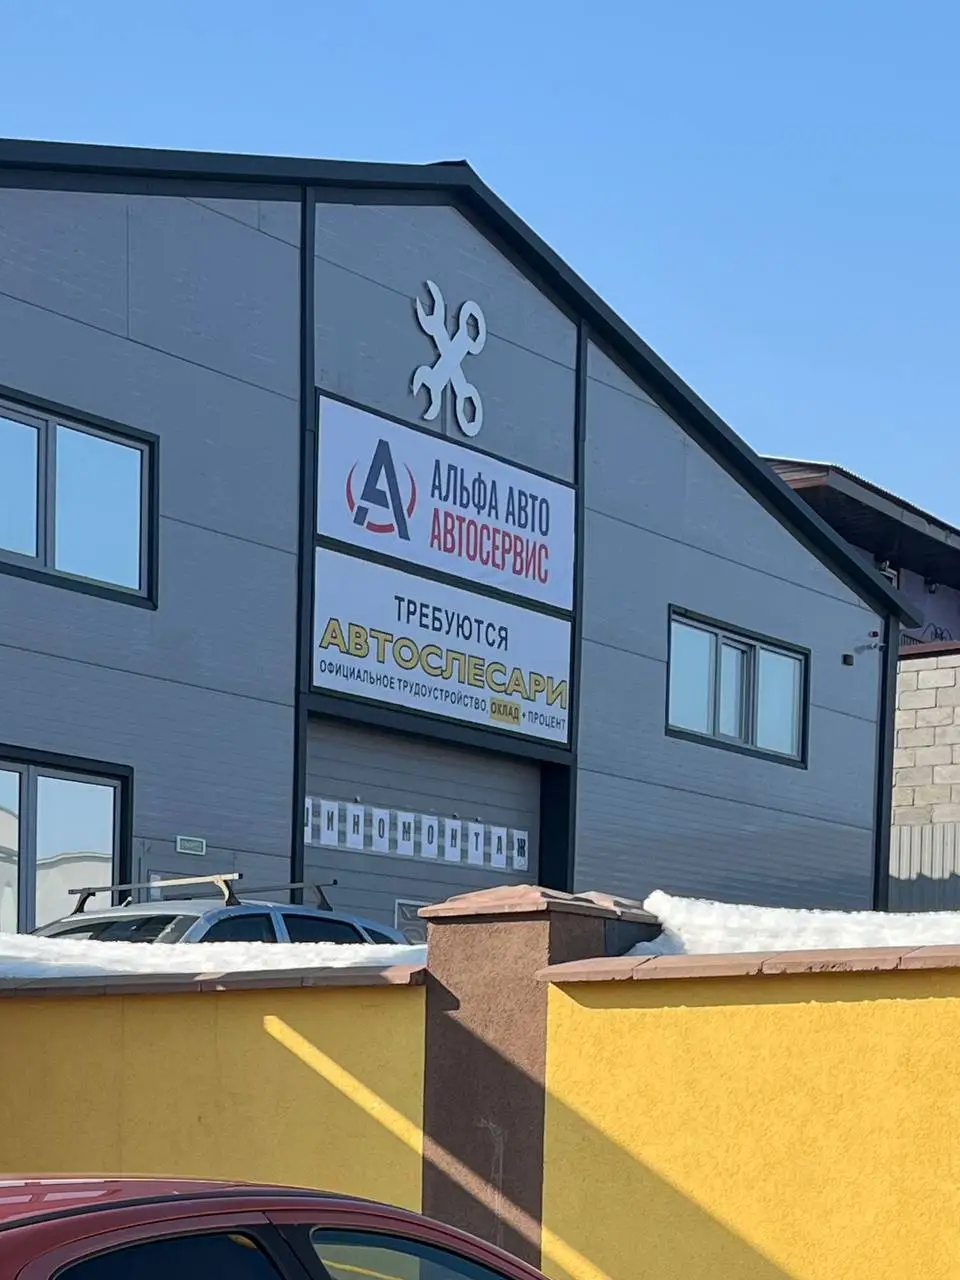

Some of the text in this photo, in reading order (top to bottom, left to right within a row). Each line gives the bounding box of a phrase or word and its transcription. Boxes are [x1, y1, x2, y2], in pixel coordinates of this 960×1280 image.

[430, 459, 550, 537] АЛЬФА АВТО
[429, 507, 549, 585] АВТОСЕРВИС
[394, 595, 508, 651] ТРЕБУЮТСЯ
[319, 617, 568, 710] АВТОСЛЕСАРИ
[319, 659, 395, 690] ОФИЦИАЛЬНОЕ
[490, 702, 520, 721] ОКЛАД
[527, 711, 566, 731] ПРОЦЕНТ
